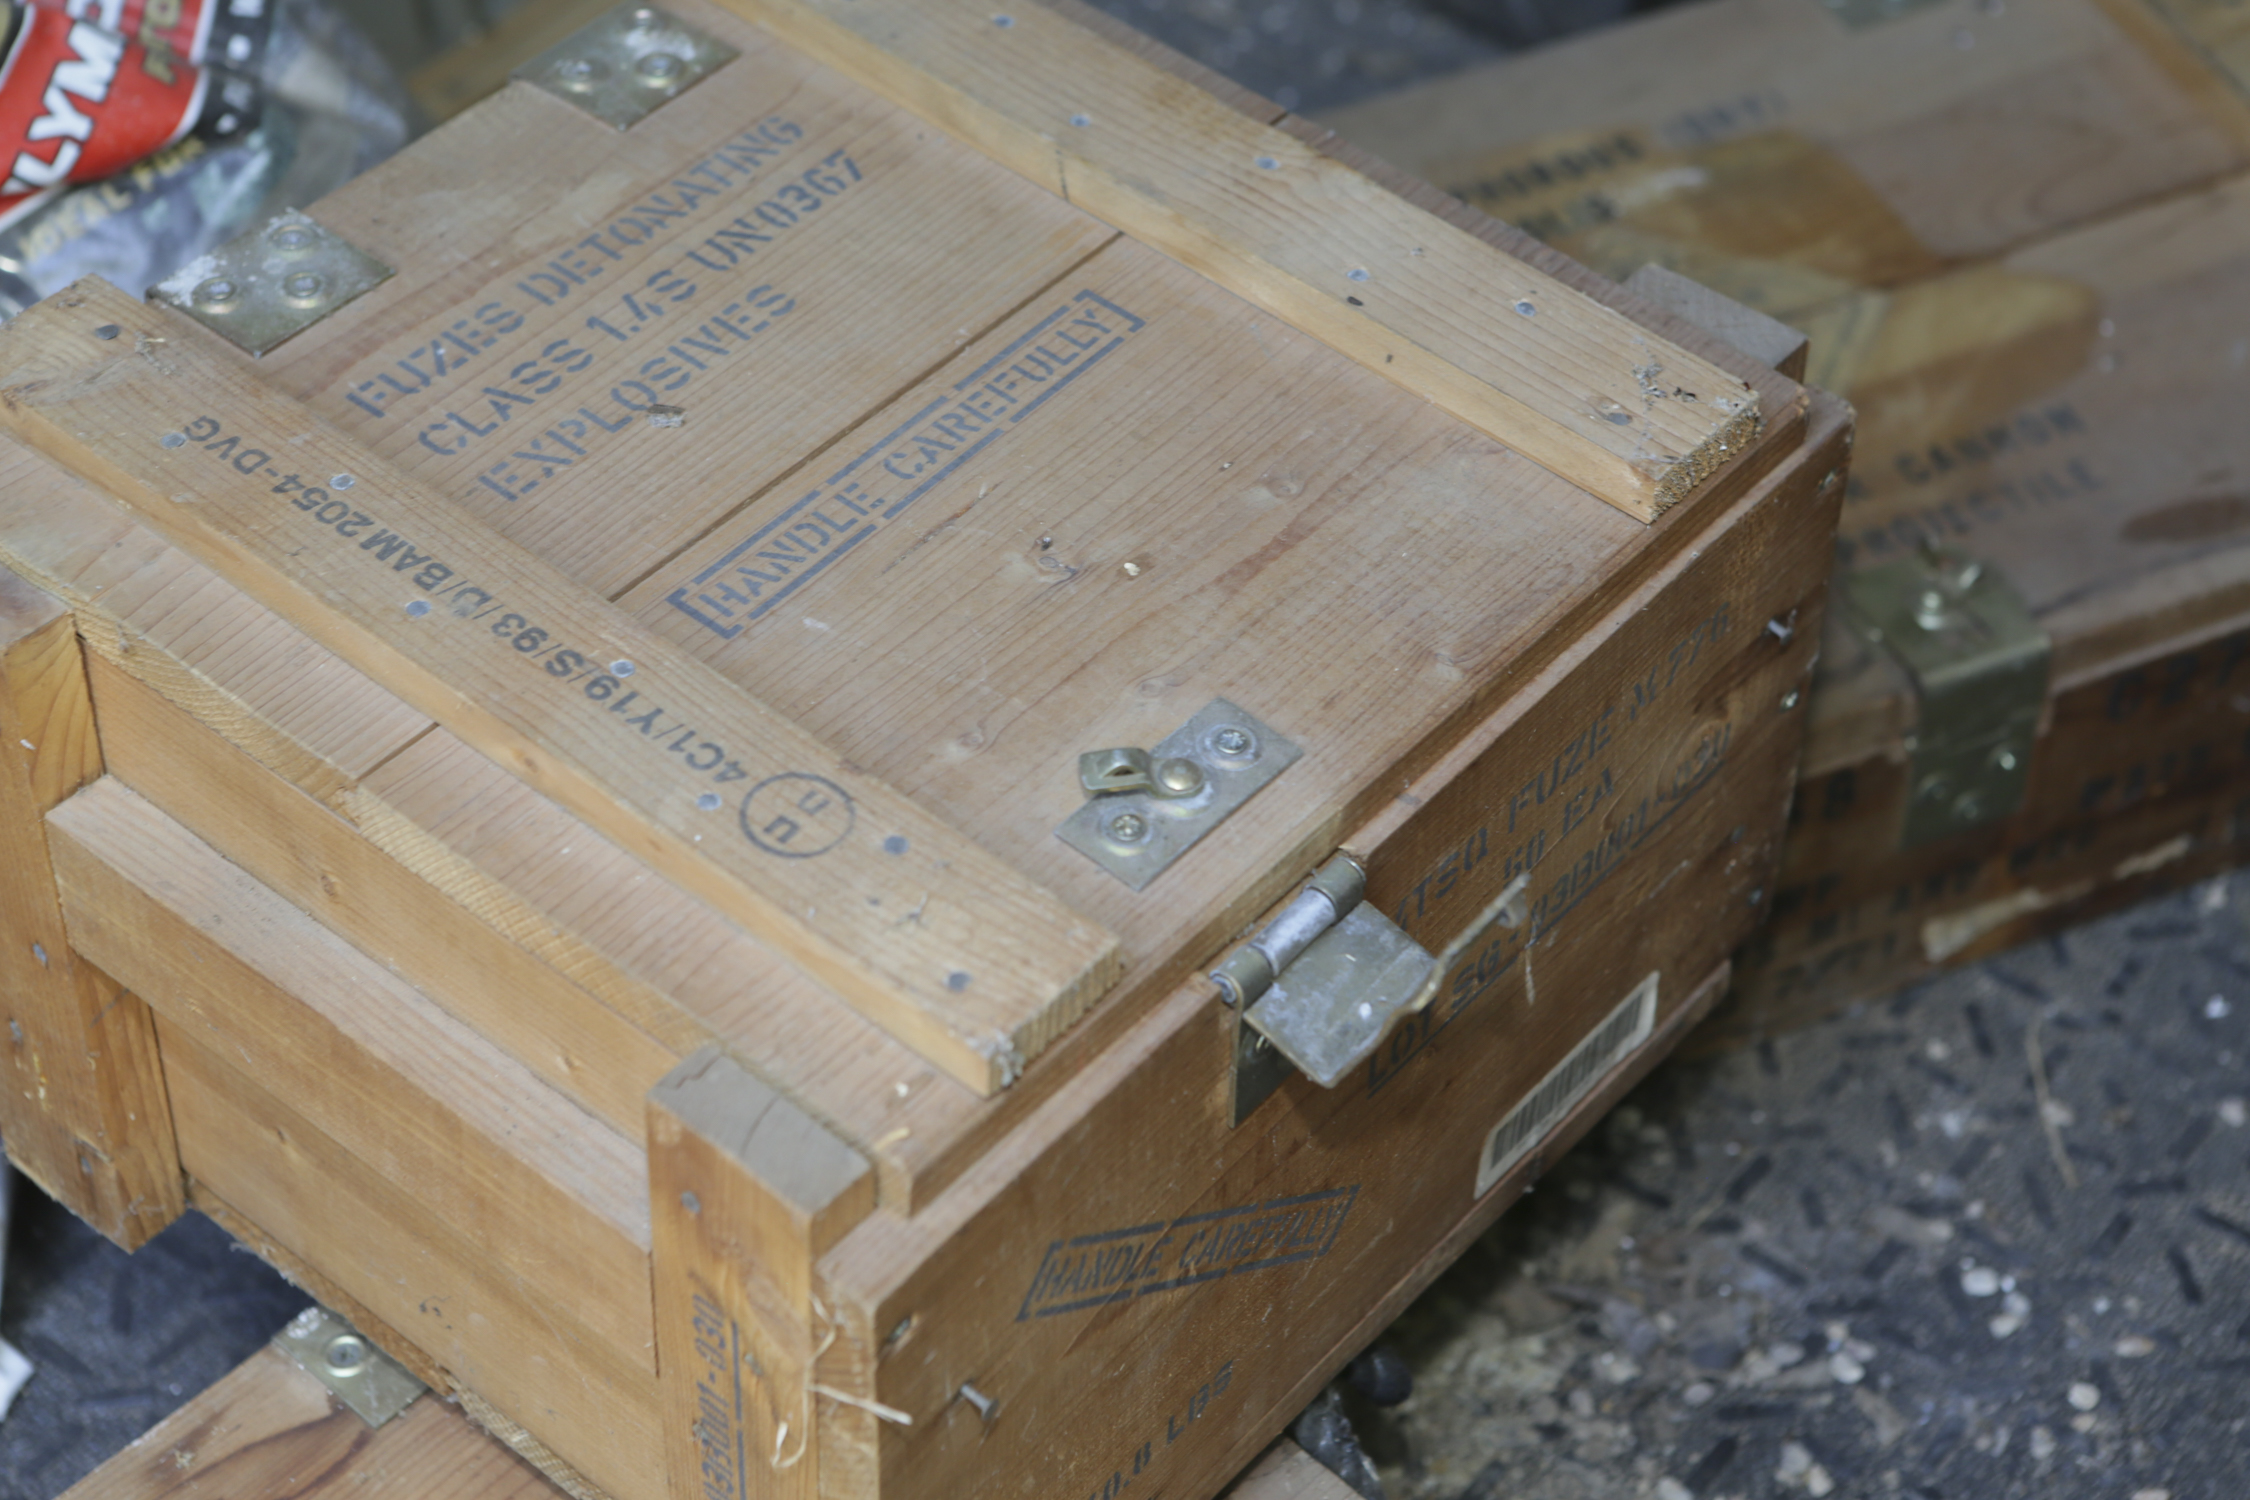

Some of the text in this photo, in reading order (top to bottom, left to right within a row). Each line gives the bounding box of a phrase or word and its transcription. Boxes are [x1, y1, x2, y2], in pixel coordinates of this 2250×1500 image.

[344, 115, 803, 418] FUZES DETONATING
[417, 338, 594, 456] CLASS
[585, 268, 697, 342] 1.4S
[477, 283, 797, 502] EXPLOSIVES
[698, 307, 1112, 617] HANDLE CAREFULLY
[1507, 705, 1616, 834] FUZE
[1562, 766, 1615, 835] EA
[1367, 995, 1438, 1091] LOT
[1035, 1200, 1346, 1303] HANDLE CAREFULLY
[1166, 1359, 1234, 1445] LBS
